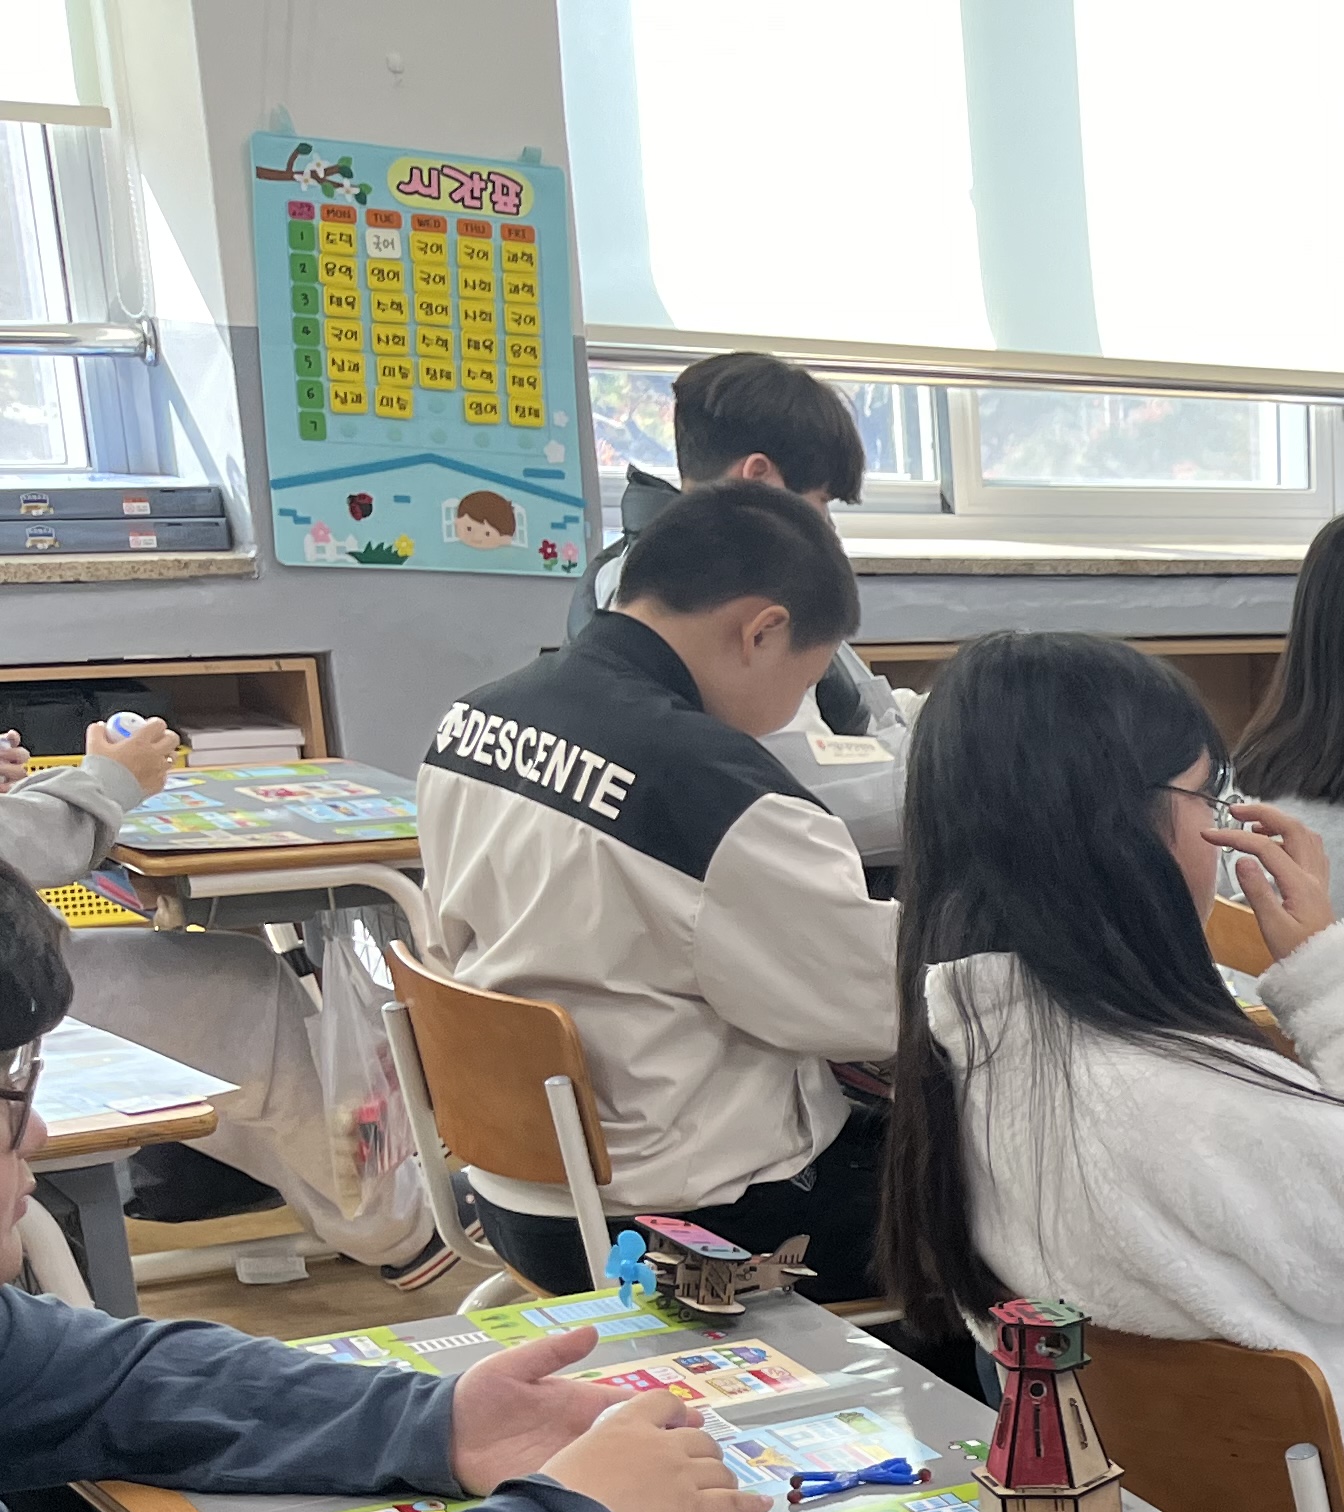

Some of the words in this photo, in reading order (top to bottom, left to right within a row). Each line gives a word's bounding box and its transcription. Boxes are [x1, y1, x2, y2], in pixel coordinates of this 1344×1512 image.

[397, 164, 523, 216] 시간표
[327, 208, 350, 219] MON
[373, 212, 395, 223] TUE
[417, 217, 441, 229] WED
[464, 223, 486, 234] THU
[508, 227, 526, 238] FRI
[373, 234, 395, 252] 국어
[416, 239, 443, 255] 국어
[463, 245, 489, 261] 국어
[300, 262, 307, 273] 2
[324, 262, 353, 280] 음악
[371, 266, 400, 282] 영어
[419, 270, 446, 285] 국어
[464, 278, 492, 293] 사회
[301, 294, 309, 306] 3
[419, 301, 449, 316] 영어
[464, 308, 492, 323] 사회
[510, 312, 536, 327] 국어
[301, 325, 311, 335] 4
[330, 326, 358, 342] 국어
[376, 333, 406, 347] 사회
[510, 343, 538, 360] 음악
[304, 356, 312, 369] 5
[306, 388, 315, 400] 6
[469, 401, 498, 417] 영어
[310, 420, 317, 432] 7
[456, 708, 636, 820] DESCENTE
